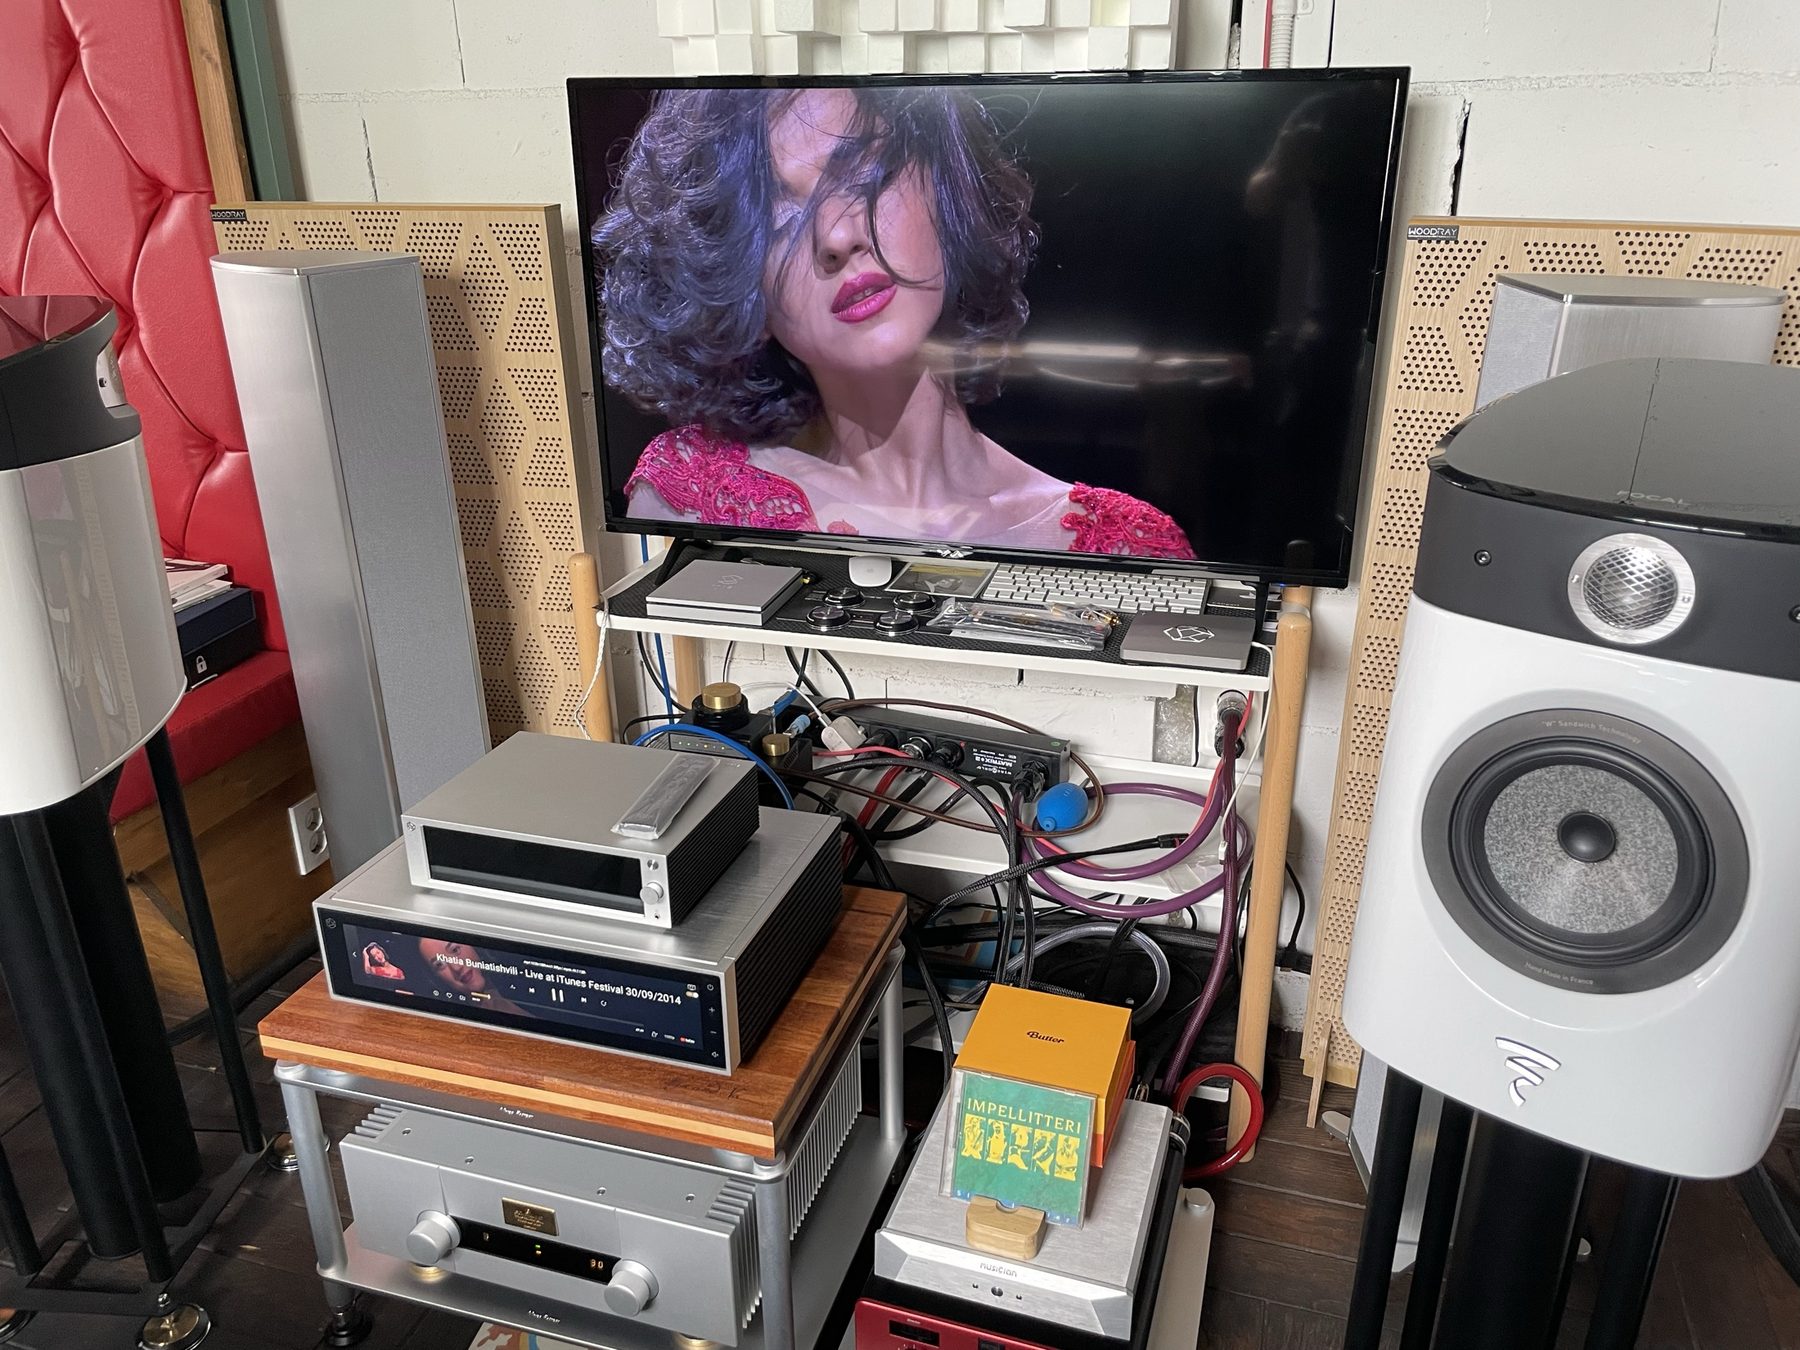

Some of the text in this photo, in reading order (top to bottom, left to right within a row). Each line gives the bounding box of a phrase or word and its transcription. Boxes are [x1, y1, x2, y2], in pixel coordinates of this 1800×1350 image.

[1408, 227, 1458, 236] WOODRAY
[1558, 720, 1597, 730] Sandwich
[436, 953, 464, 966] Khatia
[465, 958, 518, 976] Buniatishvili
[524, 968, 544, 980] Live
[545, 972, 555, 983] at
[556, 974, 587, 988] iTunes
[588, 980, 624, 995] Festival
[625, 986, 682, 1005] 30/09/2014
[1026, 1030, 1065, 1043] Butter
[966, 1097, 1082, 1135] IMPELLITTERI
